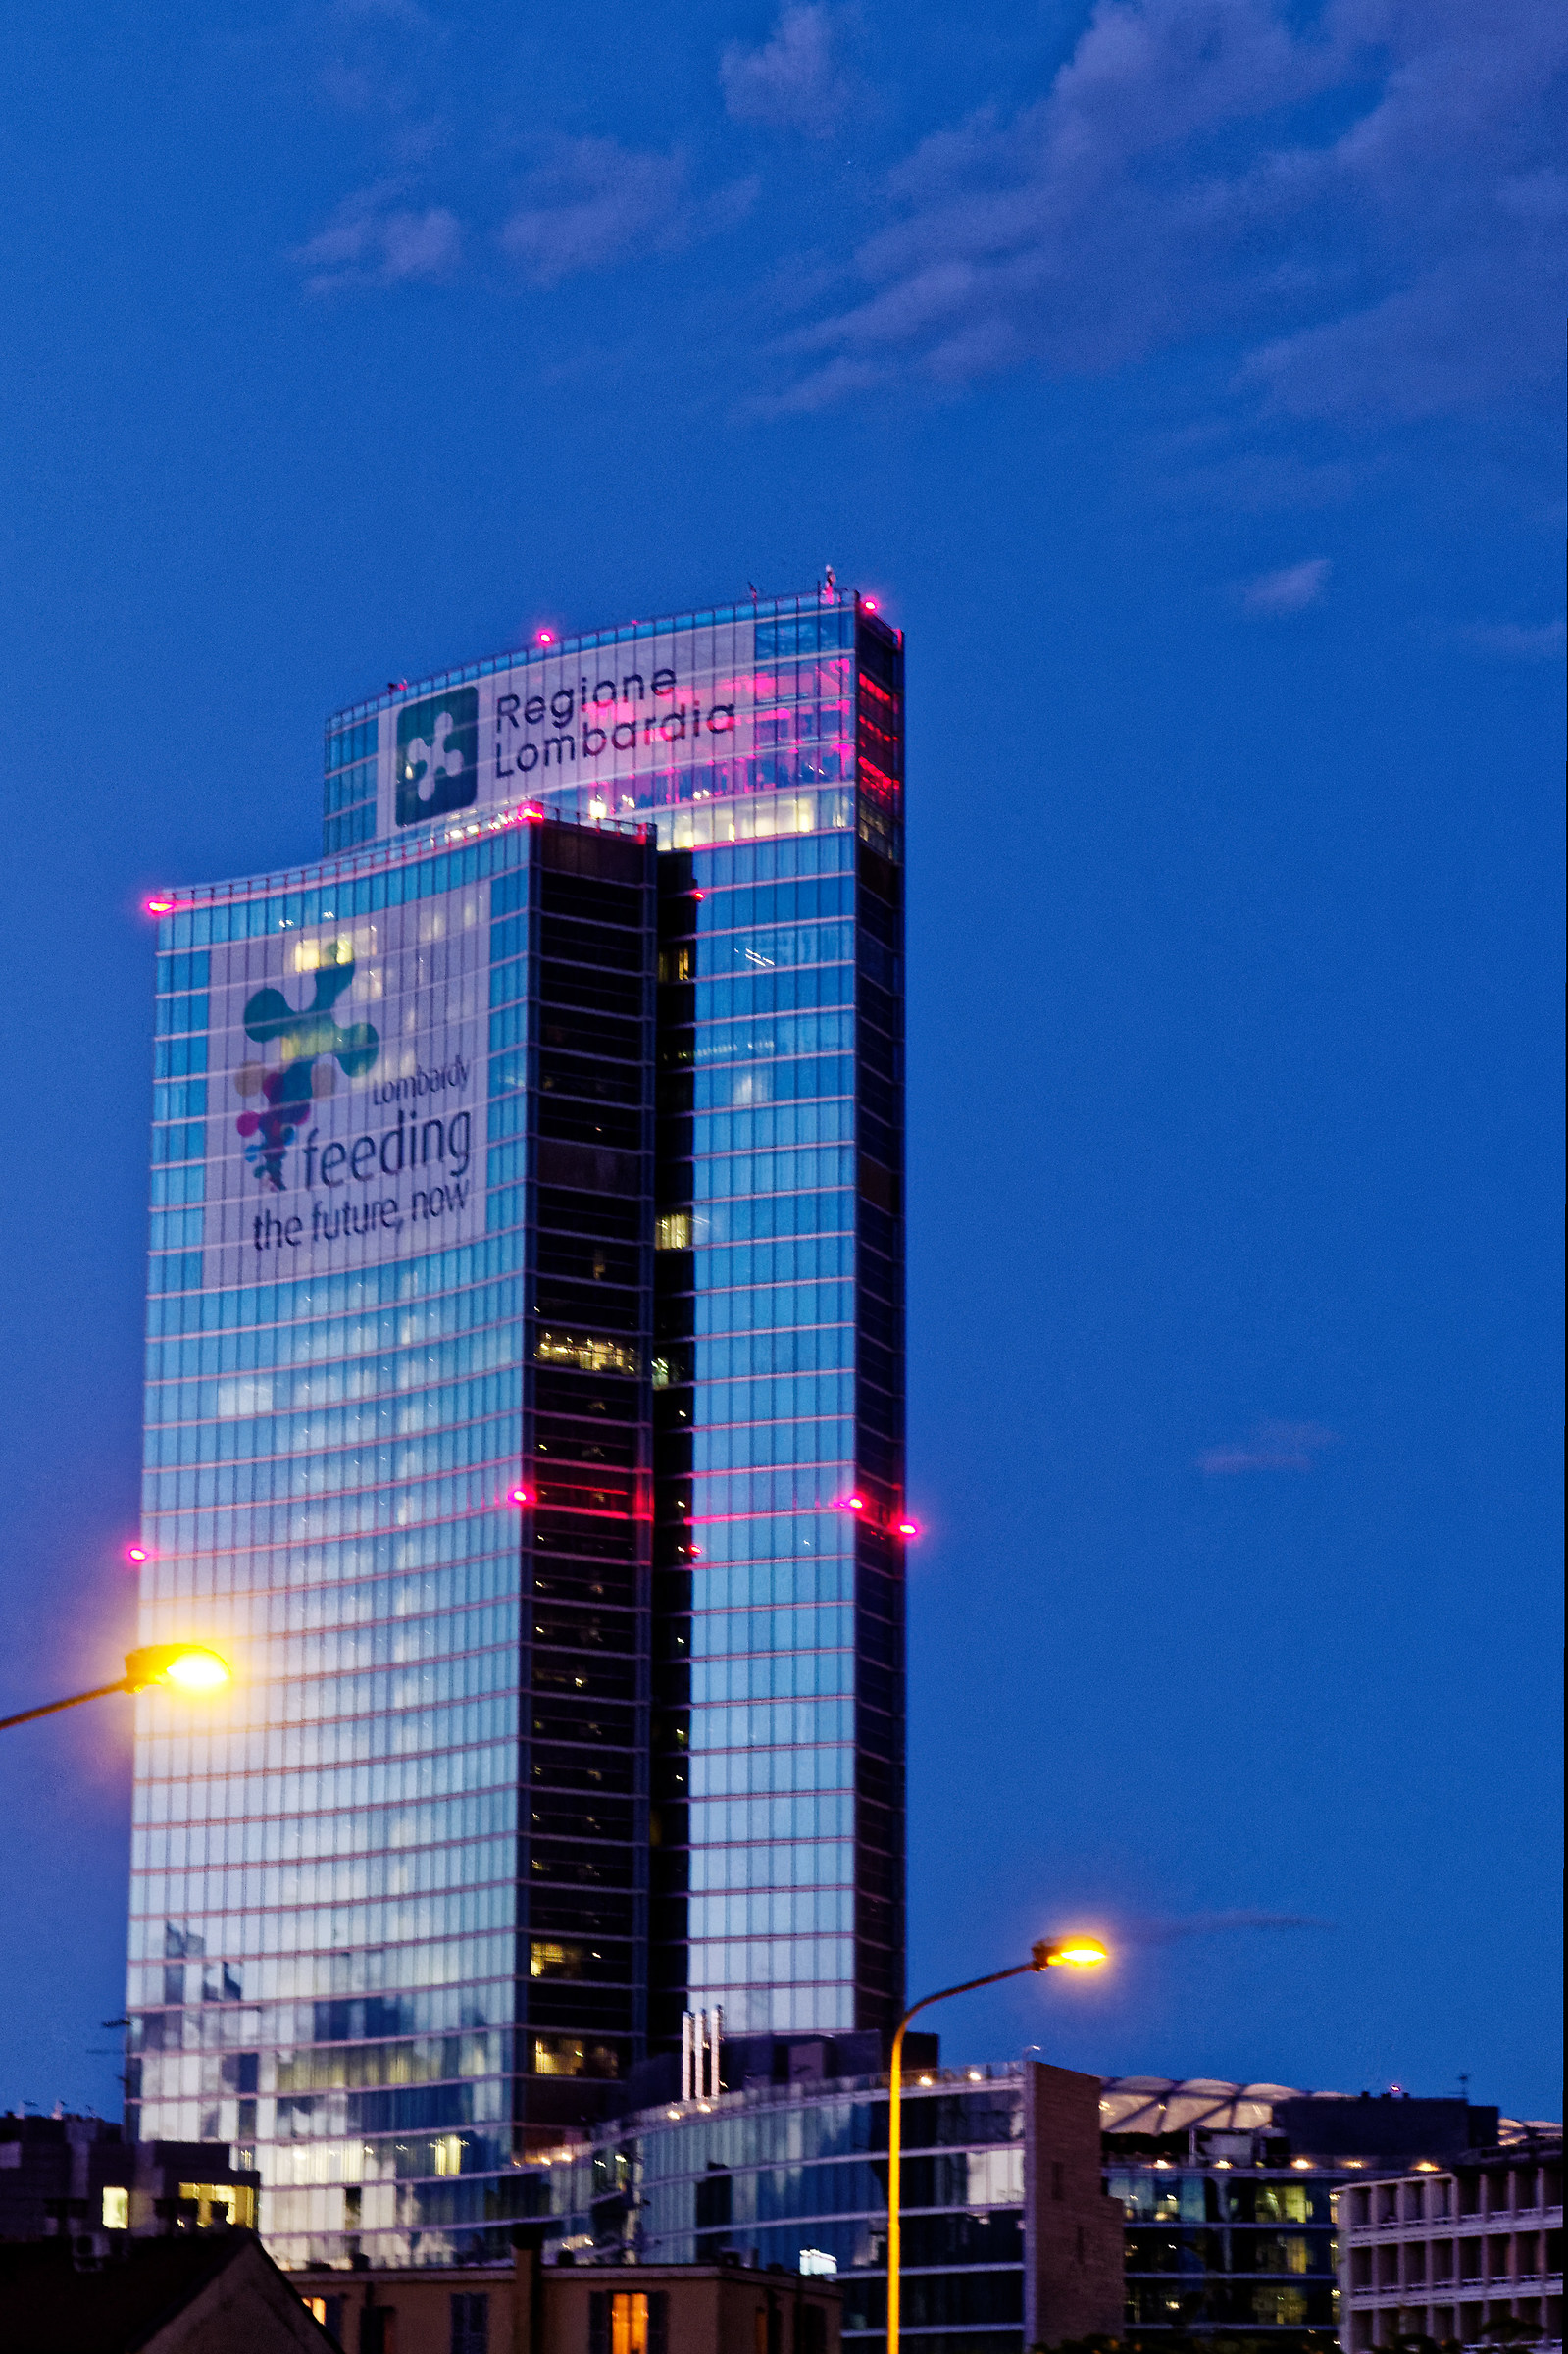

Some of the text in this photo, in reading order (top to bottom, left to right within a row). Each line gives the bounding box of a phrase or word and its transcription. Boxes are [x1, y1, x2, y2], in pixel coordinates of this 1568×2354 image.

[496, 668, 677, 734] Regione
[495, 700, 734, 778] Lombardia
[373, 1054, 470, 1105] Lombardy
[303, 1109, 471, 1191] feeding
[254, 1179, 470, 1251] the future, now
